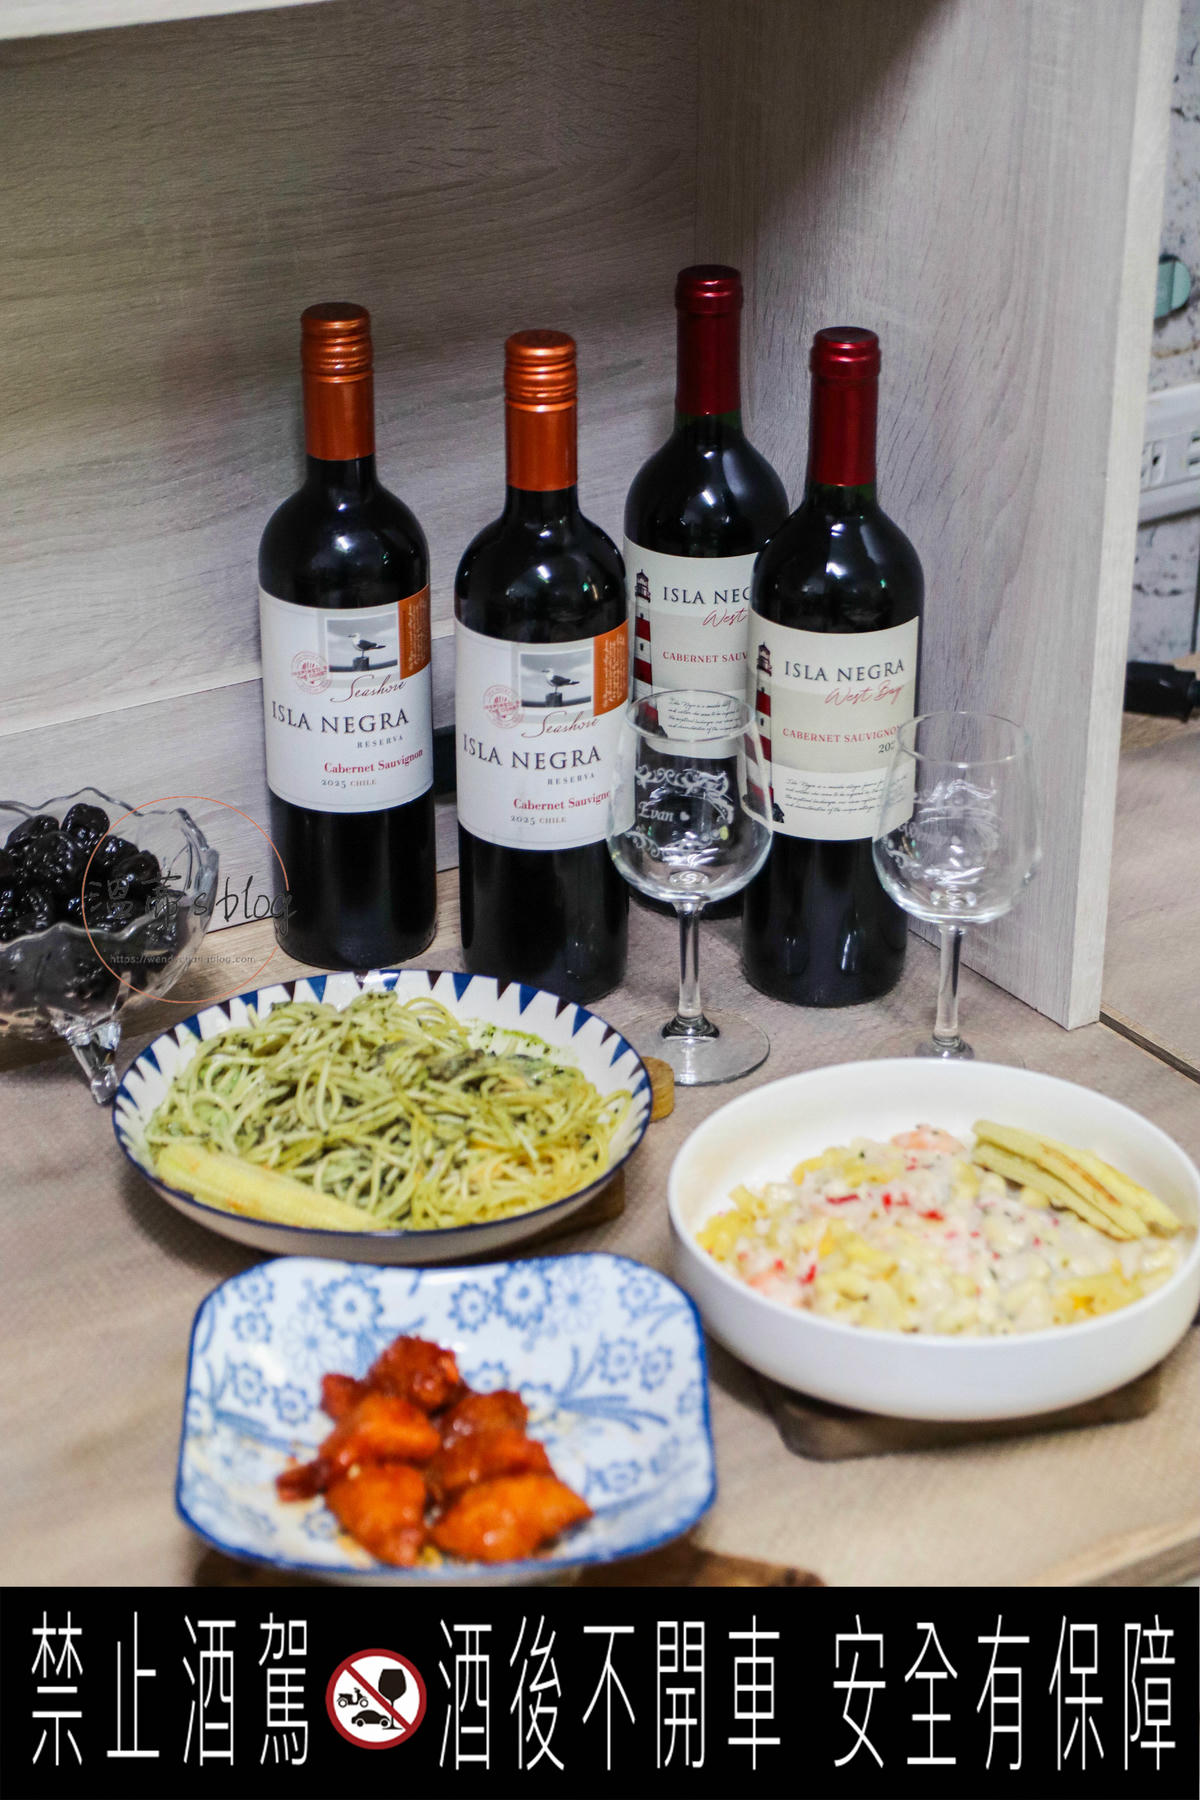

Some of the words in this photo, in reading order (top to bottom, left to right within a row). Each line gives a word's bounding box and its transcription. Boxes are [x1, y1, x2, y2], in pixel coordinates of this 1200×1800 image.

[663, 586, 706, 604] ISLA
[714, 586, 751, 604] NEG
[702, 607, 749, 628] West
[662, 651, 719, 663] CABERNET
[721, 651, 748, 662] SAUV
[785, 661, 829, 682] ISLA
[837, 659, 905, 682] NEGRA
[330, 674, 407, 703] Seashore
[824, 687, 872, 706] West
[272, 701, 312, 731] ISLA
[321, 708, 409, 734] NEGRA
[521, 710, 601, 739] Seashore
[357, 735, 404, 749] RESERVA
[782, 727, 840, 743] CABERNET
[324, 762, 375, 774] Cabernet
[378, 748, 424, 771] Sauvignon
[463, 733, 503, 766] ISLA
[511, 746, 602, 771] NEGRA
[350, 779, 377, 787] CHILE
[547, 773, 595, 785] RESERVA
[513, 798, 565, 811] Cabernet
[638, 801, 674, 822] Evan
[539, 816, 567, 824] CHILE
